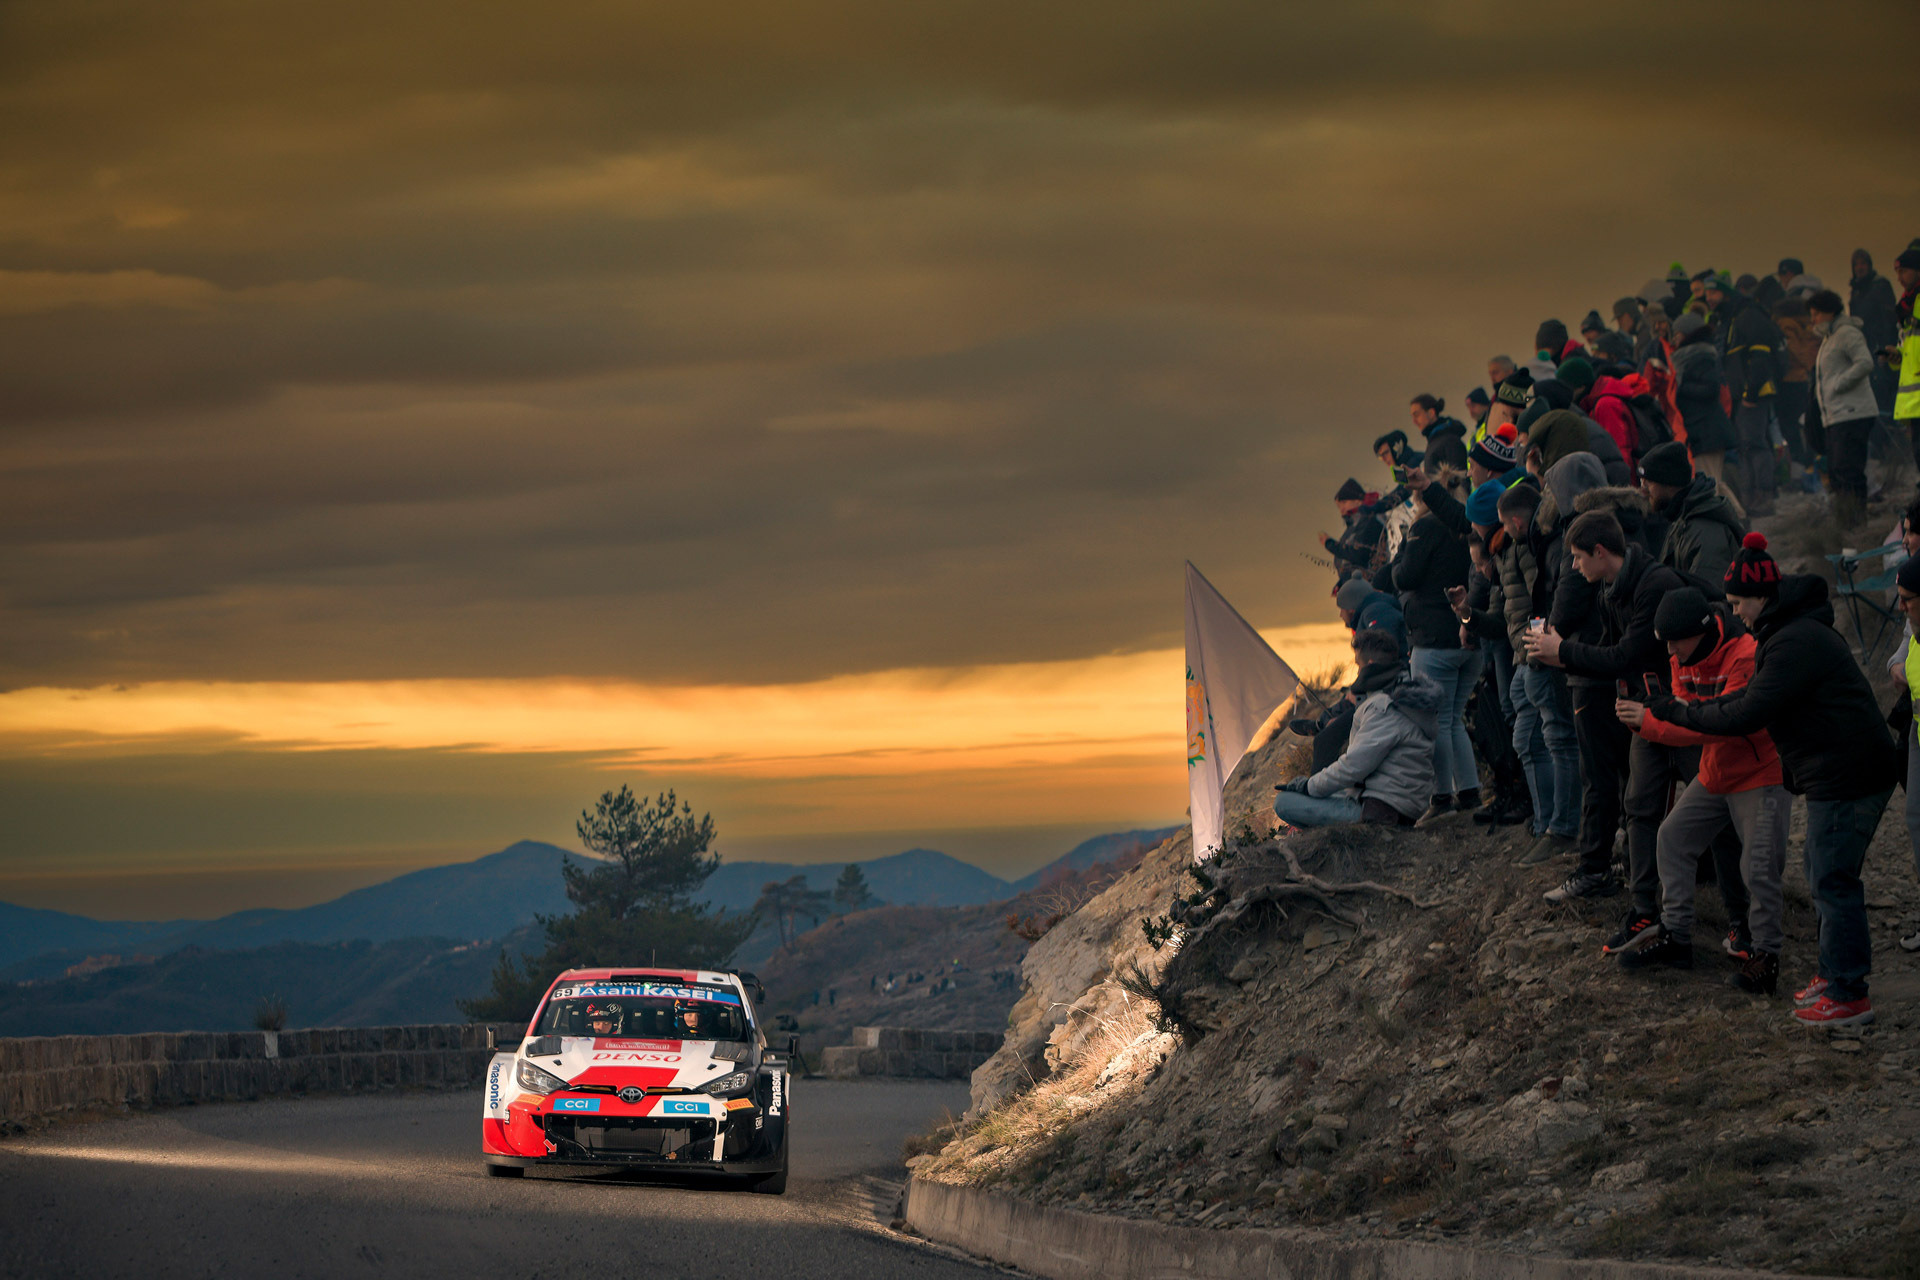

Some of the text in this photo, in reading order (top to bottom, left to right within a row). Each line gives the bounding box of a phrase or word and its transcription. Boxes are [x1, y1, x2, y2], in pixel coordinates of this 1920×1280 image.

[1484, 438, 1513, 457] RALLY
[1749, 796, 1778, 881] TRAINING
[553, 988, 573, 998] 69
[685, 984, 722, 993] Racing
[592, 1052, 682, 1063] DENSO
[564, 1100, 589, 1109] CCI
[674, 1103, 699, 1112] CCI
